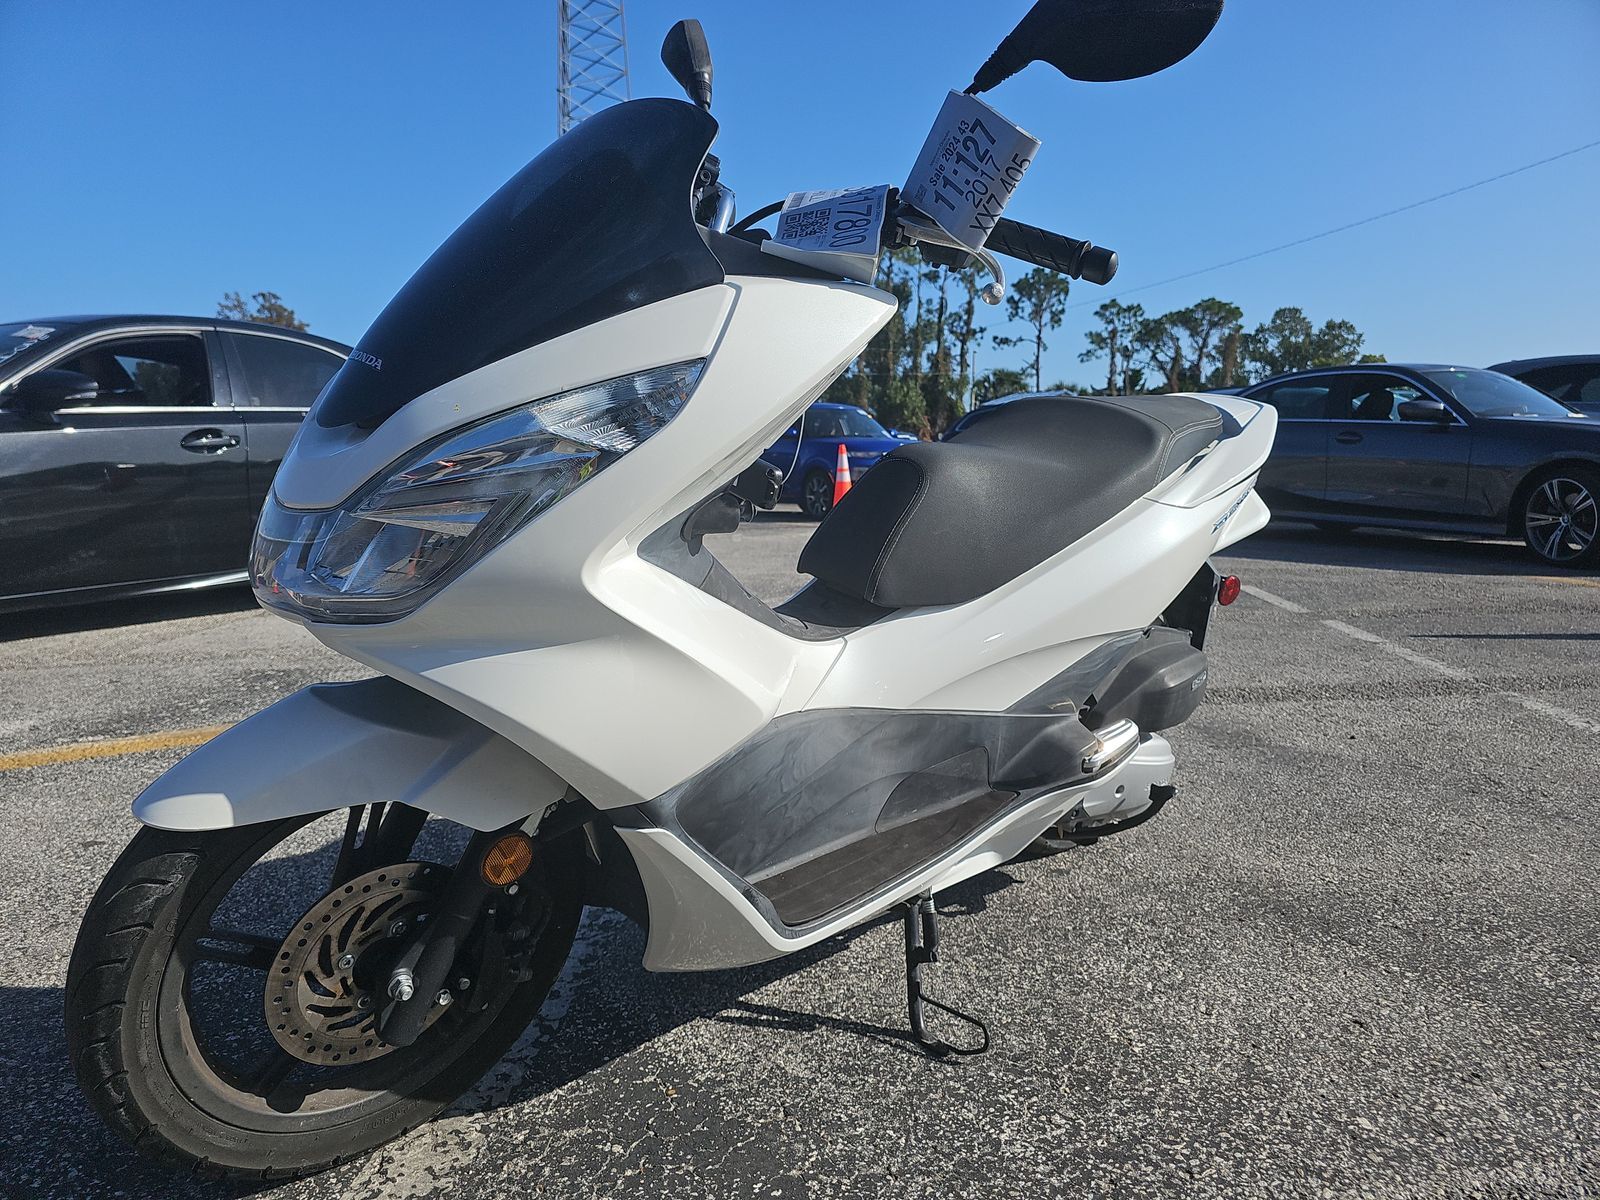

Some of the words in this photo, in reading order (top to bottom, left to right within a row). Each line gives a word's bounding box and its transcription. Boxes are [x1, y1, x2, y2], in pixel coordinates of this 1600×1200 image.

[929, 164, 946, 187] Sale
[941, 135, 961, 162] 2024
[957, 120, 970, 136] 43
[934, 117, 997, 212] 11:127
[965, 154, 1001, 210] 2017
